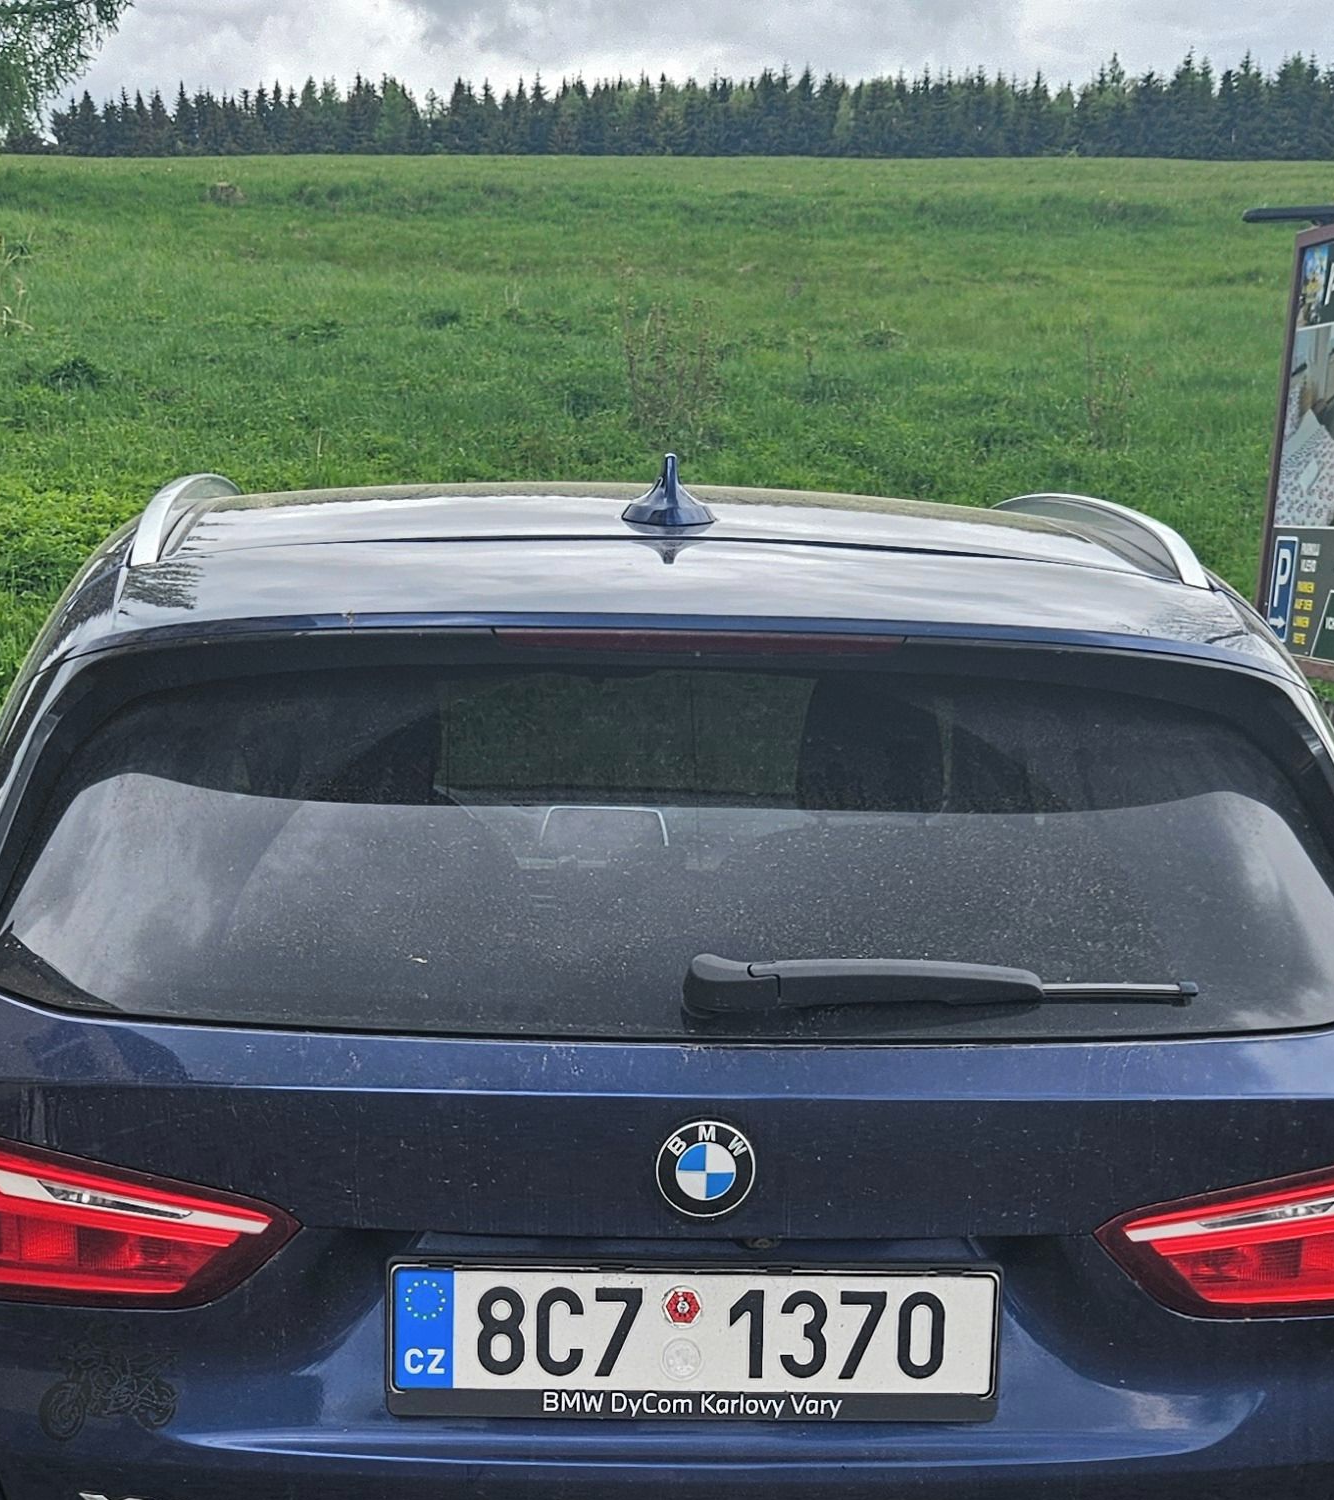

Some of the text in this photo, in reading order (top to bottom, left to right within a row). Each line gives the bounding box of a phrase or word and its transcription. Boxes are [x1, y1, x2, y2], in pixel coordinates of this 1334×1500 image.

[1273, 548, 1292, 607] P
[667, 1125, 747, 1157] BMW
[477, 1286, 946, 1380] 8C7 1370
[404, 1347, 446, 1375] CZ
[543, 1391, 843, 1419] BMW DyCom Karlovy Vary
